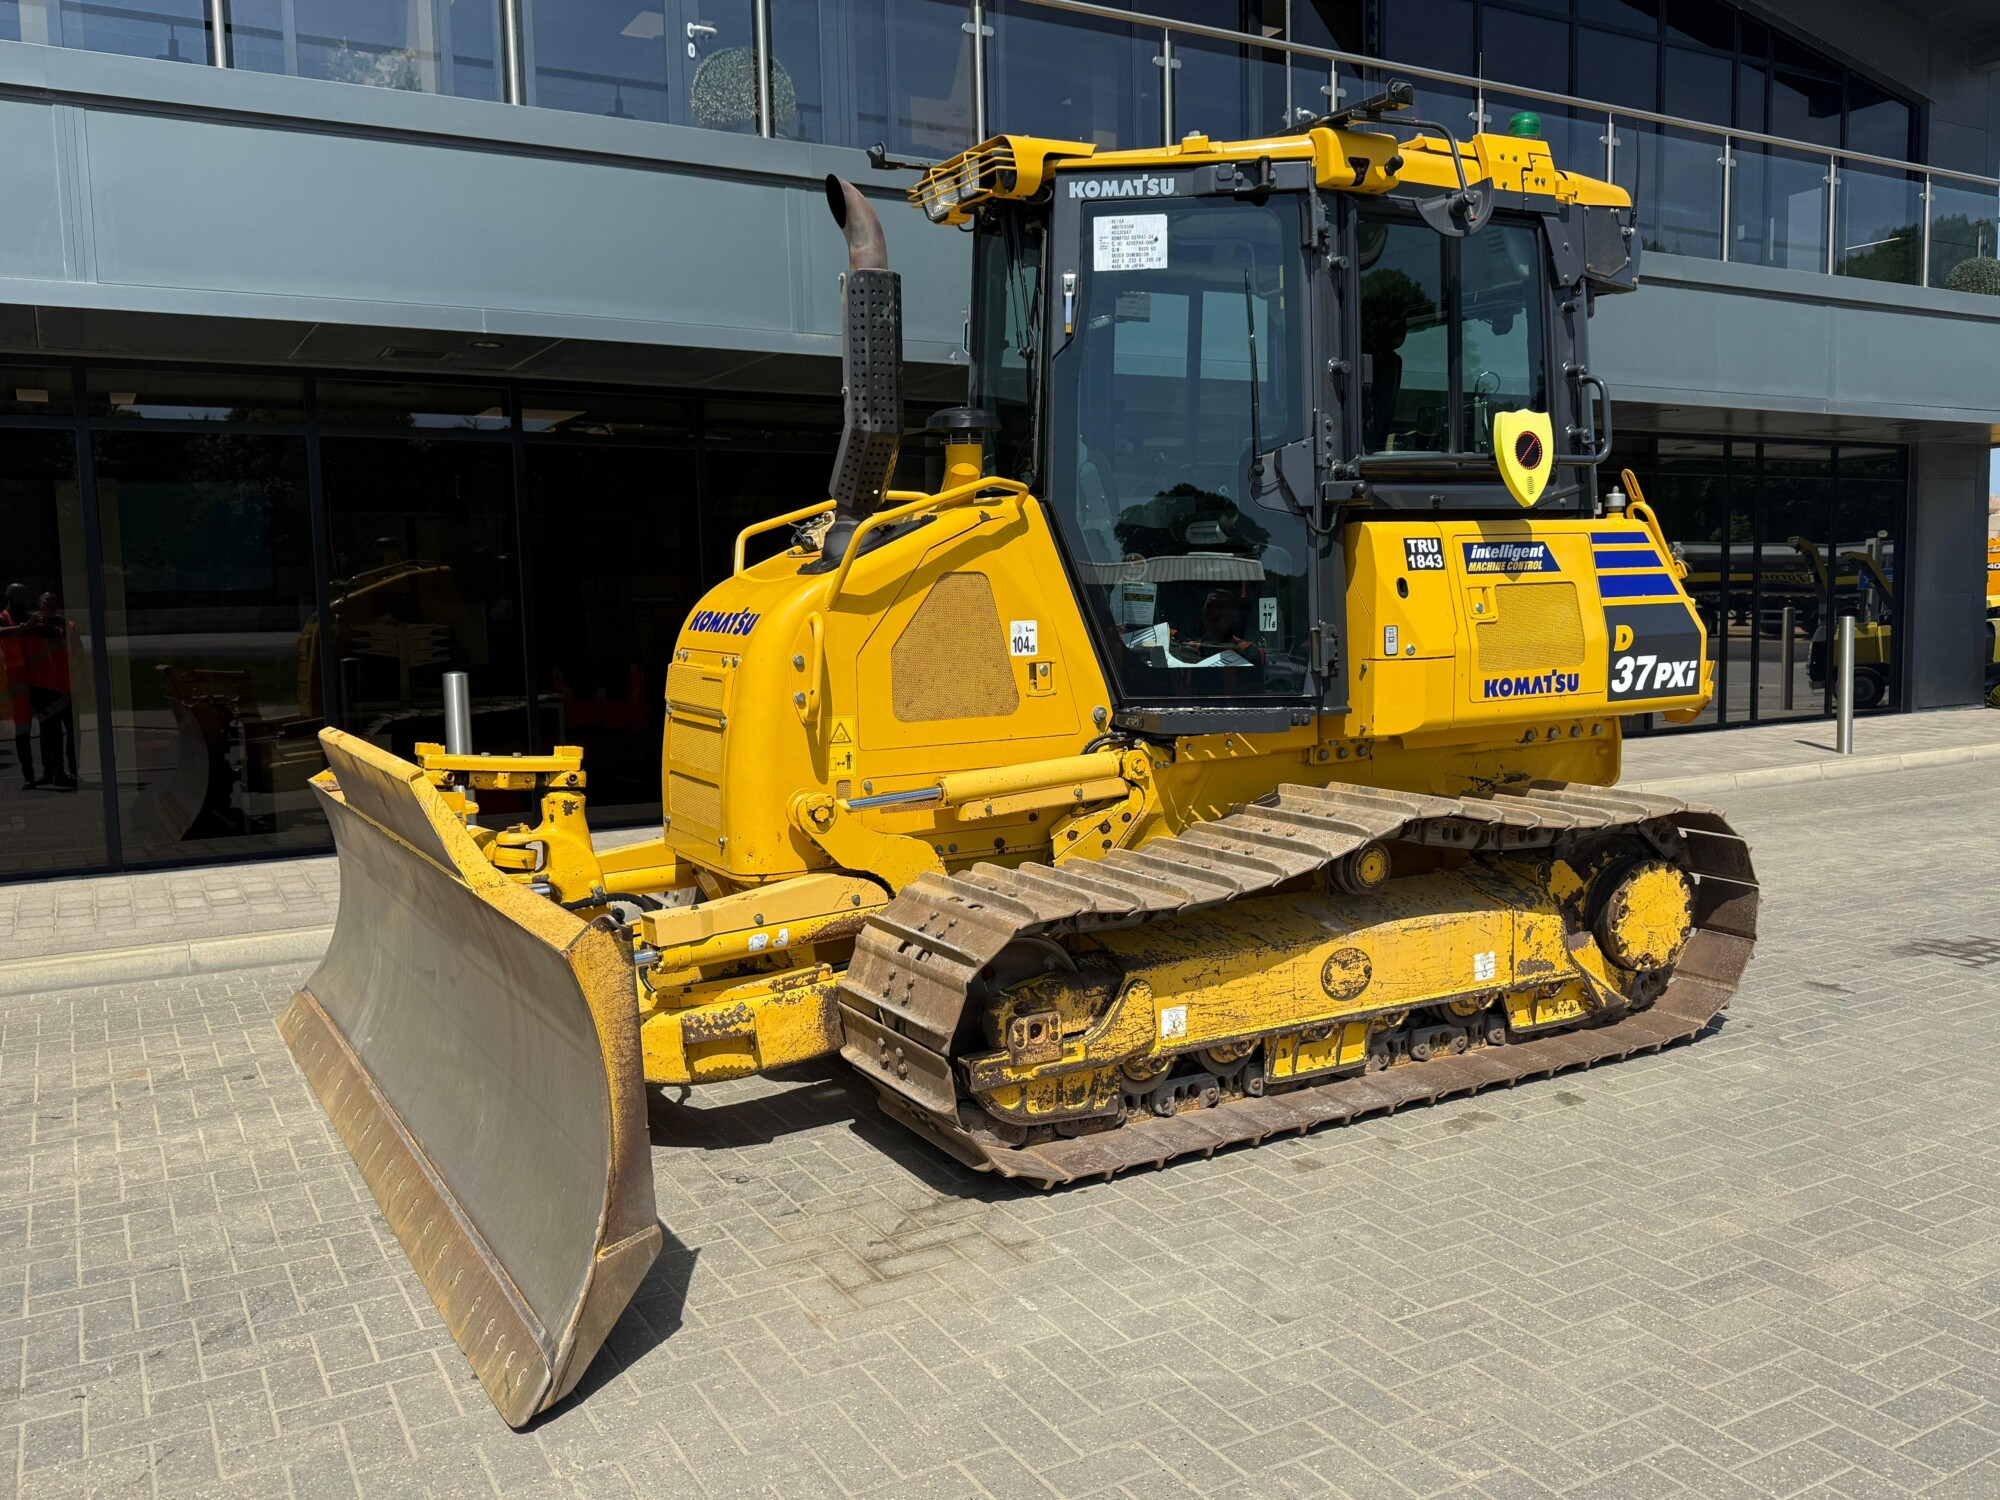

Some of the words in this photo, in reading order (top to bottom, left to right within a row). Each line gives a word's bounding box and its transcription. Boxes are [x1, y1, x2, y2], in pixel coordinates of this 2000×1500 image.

[1069, 174, 1175, 198] KOMATSU
[1407, 539, 1439, 553] TRU
[1471, 544, 1545, 562] intelligent
[1408, 553, 1444, 569] 1843
[1468, 561, 1506, 572] MACHINE
[1506, 560, 1543, 571] CONTROL
[688, 606, 761, 636] KOMATSU
[1263, 612, 1272, 629] 77
[1012, 635, 1030, 653] 104
[1614, 624, 1634, 651] D
[1611, 655, 1697, 693] 37PXi
[1484, 669, 1579, 698] KOMATSU
